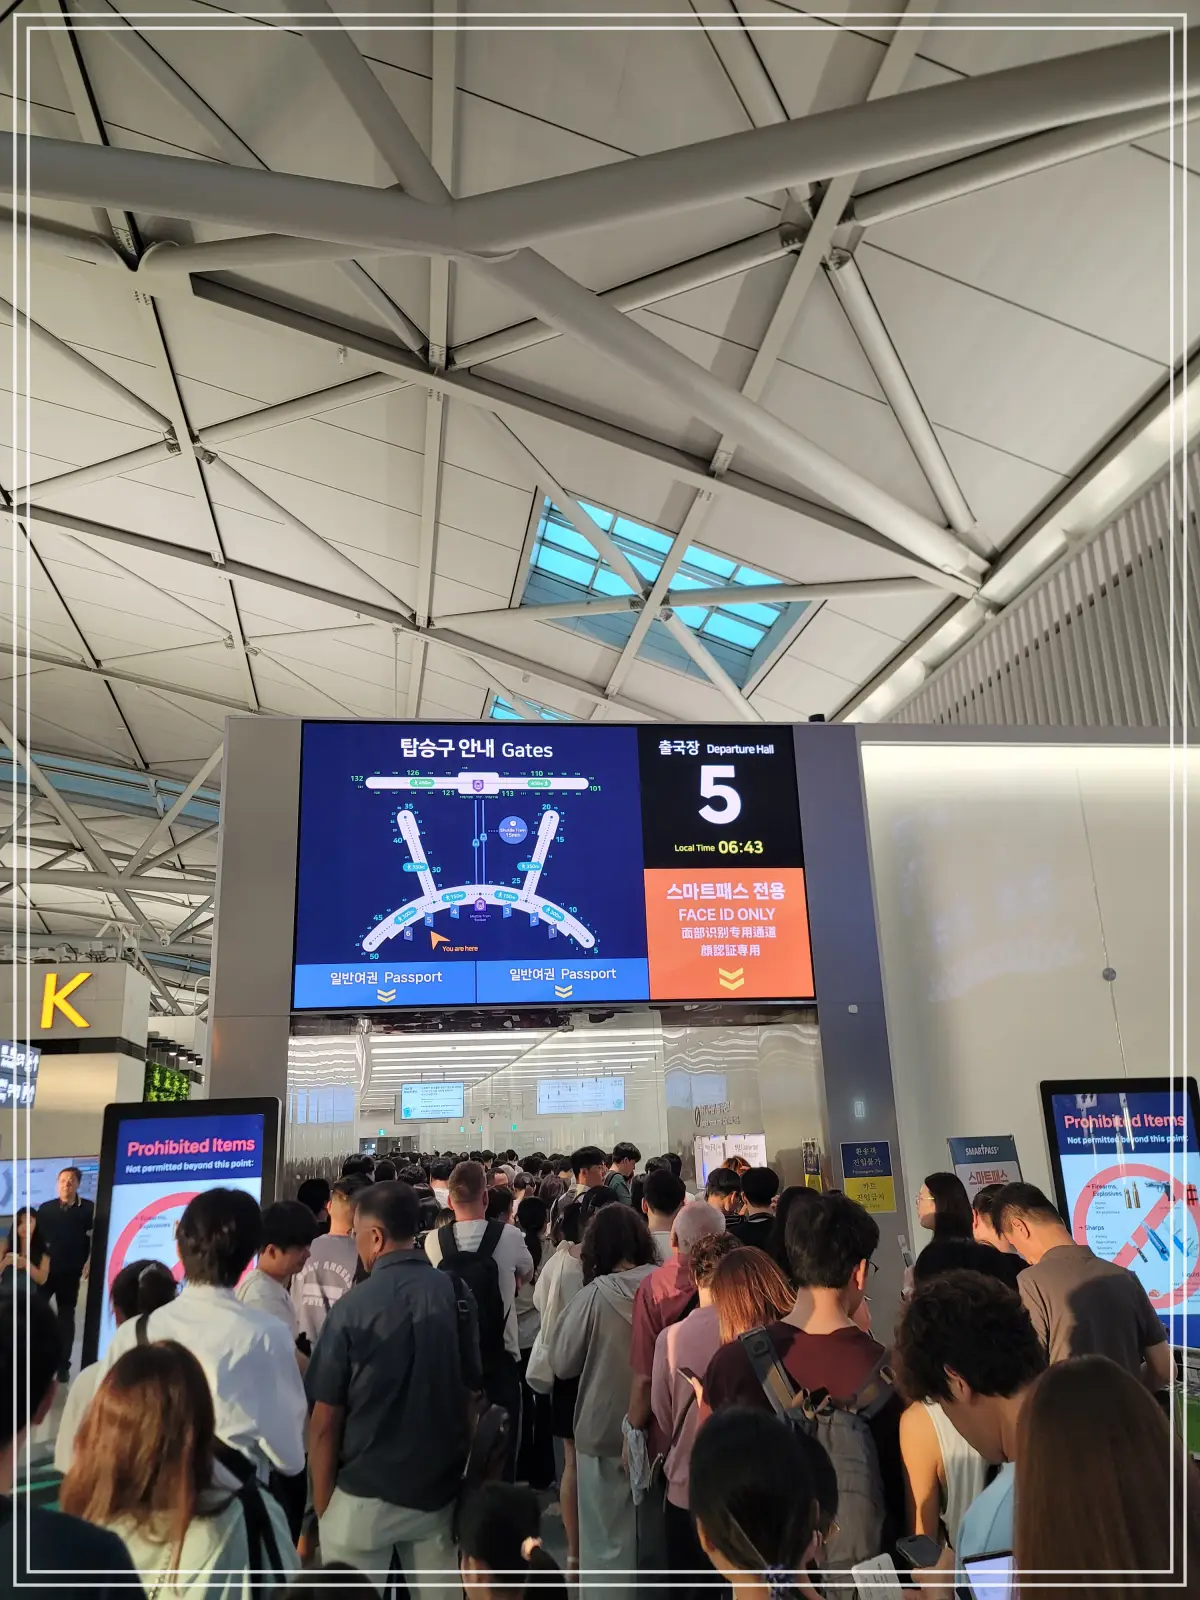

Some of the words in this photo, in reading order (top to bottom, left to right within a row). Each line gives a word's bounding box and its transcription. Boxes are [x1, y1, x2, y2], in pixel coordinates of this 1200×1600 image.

[400, 738, 455, 758] 탑승구
[458, 738, 495, 758] 안내
[501, 742, 553, 758] Gates
[659, 739, 700, 755] 출국장
[706, 744, 755, 756] Departure
[756, 744, 775, 754] Hall
[698, 764, 742, 825] 5
[674, 844, 695, 852] Local
[695, 844, 716, 852] Time
[718, 840, 764, 855] 06:43
[666, 882, 750, 900] 스마트패스
[752, 882, 786, 900] 전용
[451, 907, 457, 915] 4
[504, 907, 510, 915] 3
[678, 908, 717, 921] FACE
[719, 908, 735, 920] ID
[737, 908, 776, 920] ONLY
[426, 916, 432, 924] 5
[531, 915, 538, 923] 2
[405, 929, 412, 937] 6
[681, 926, 777, 939] 面部识别专用通道
[442, 945, 454, 953] You
[701, 944, 760, 956] 顔認証専用
[330, 971, 379, 985] 일반여권
[384, 971, 443, 984] Passport
[509, 968, 555, 981] 일반여권
[560, 968, 617, 981] Passport
[40, 972, 92, 1029] K
[1063, 1113, 1141, 1129] Prohibitd
[1143, 1113, 1185, 1127] Items
[1067, 1136, 1081, 1144] Not
[1121, 1134, 1149, 1145] beond
[1149, 1134, 1165, 1143] this
[127, 1138, 209, 1157] Prohibited
[212, 1137, 255, 1153] Items
[125, 1164, 141, 1174] Not
[142, 1162, 182, 1174] permitted
[183, 1160, 213, 1172] beyond
[214, 1159, 230, 1169] this
[230, 1158, 254, 1170] point:
[968, 1170, 1010, 1186] 스마트패스
[1084, 1224, 1105, 1232] Sharps
